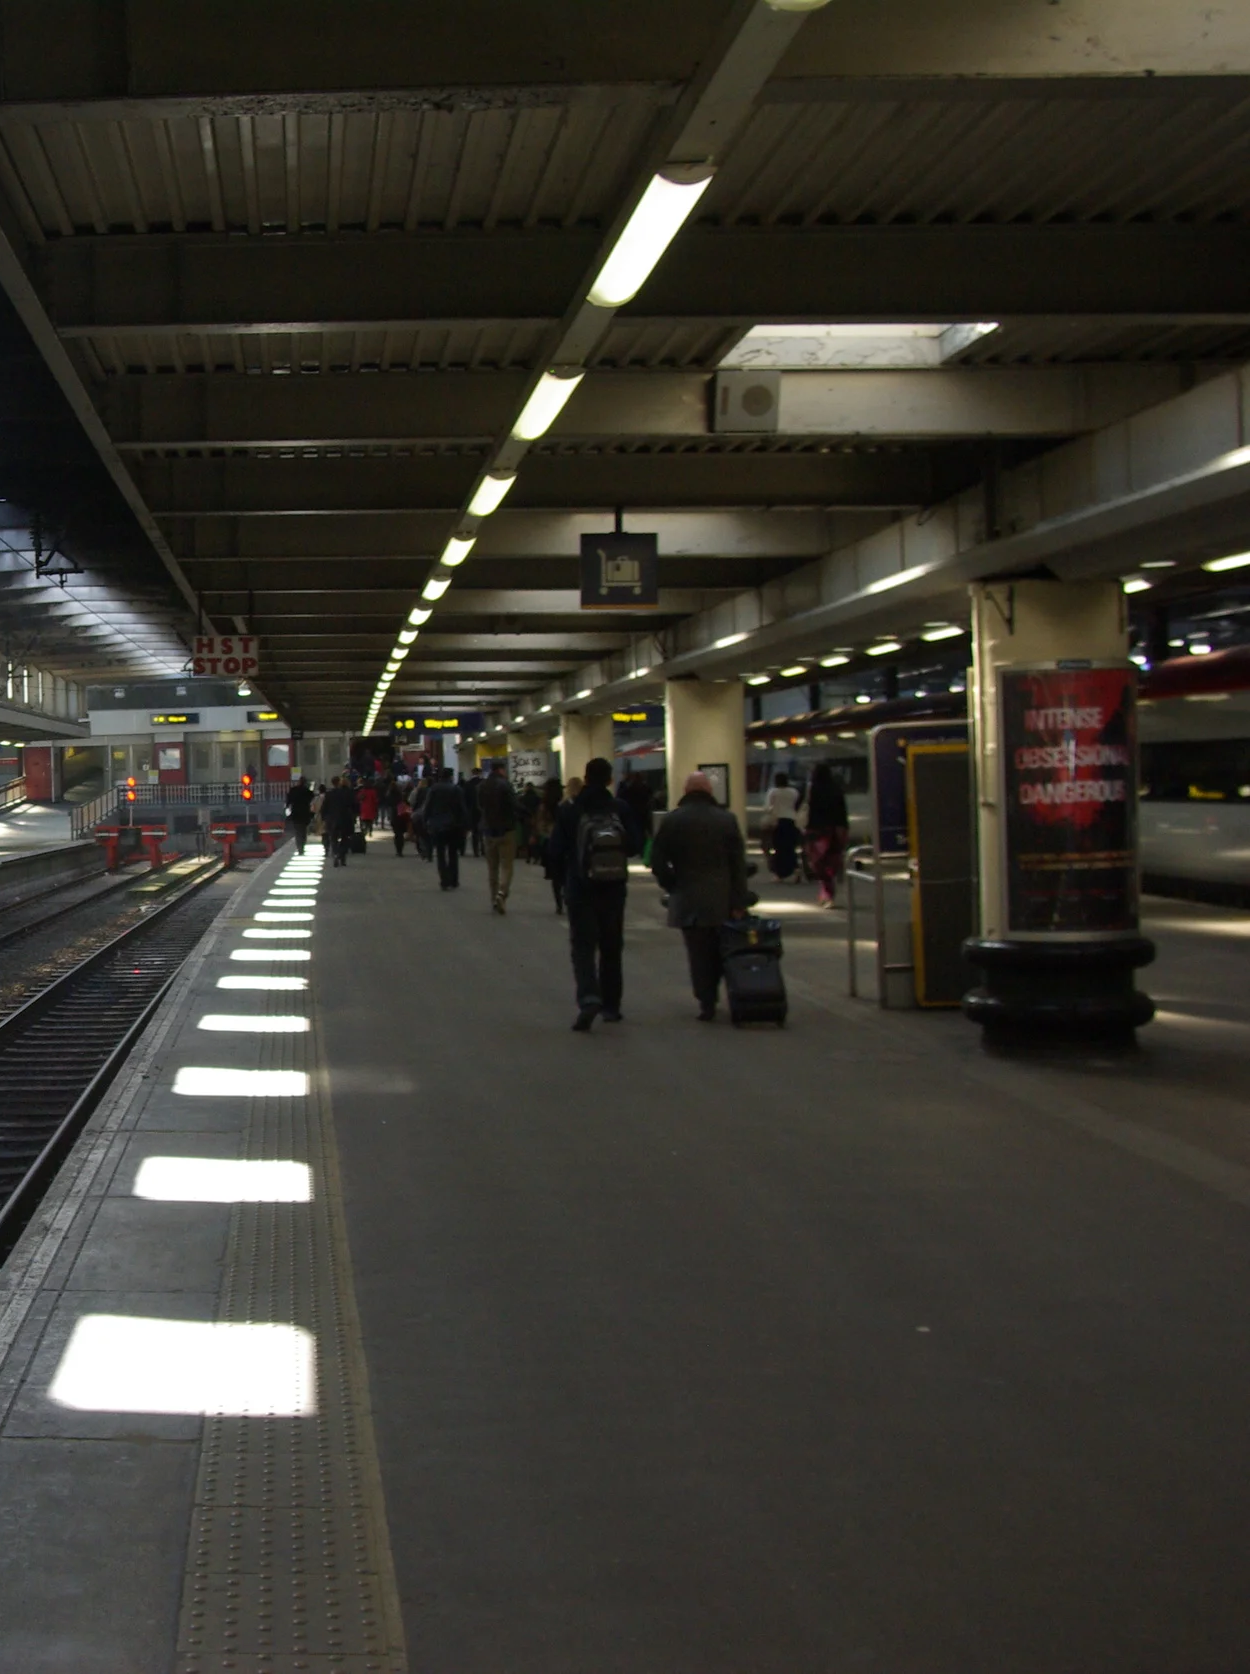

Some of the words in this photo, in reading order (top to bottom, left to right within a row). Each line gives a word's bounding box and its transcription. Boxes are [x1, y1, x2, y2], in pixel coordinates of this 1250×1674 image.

[193, 656, 258, 675] STOP
[1025, 707, 1103, 730] INTENSE
[1019, 780, 1127, 805] DANGEROUS
